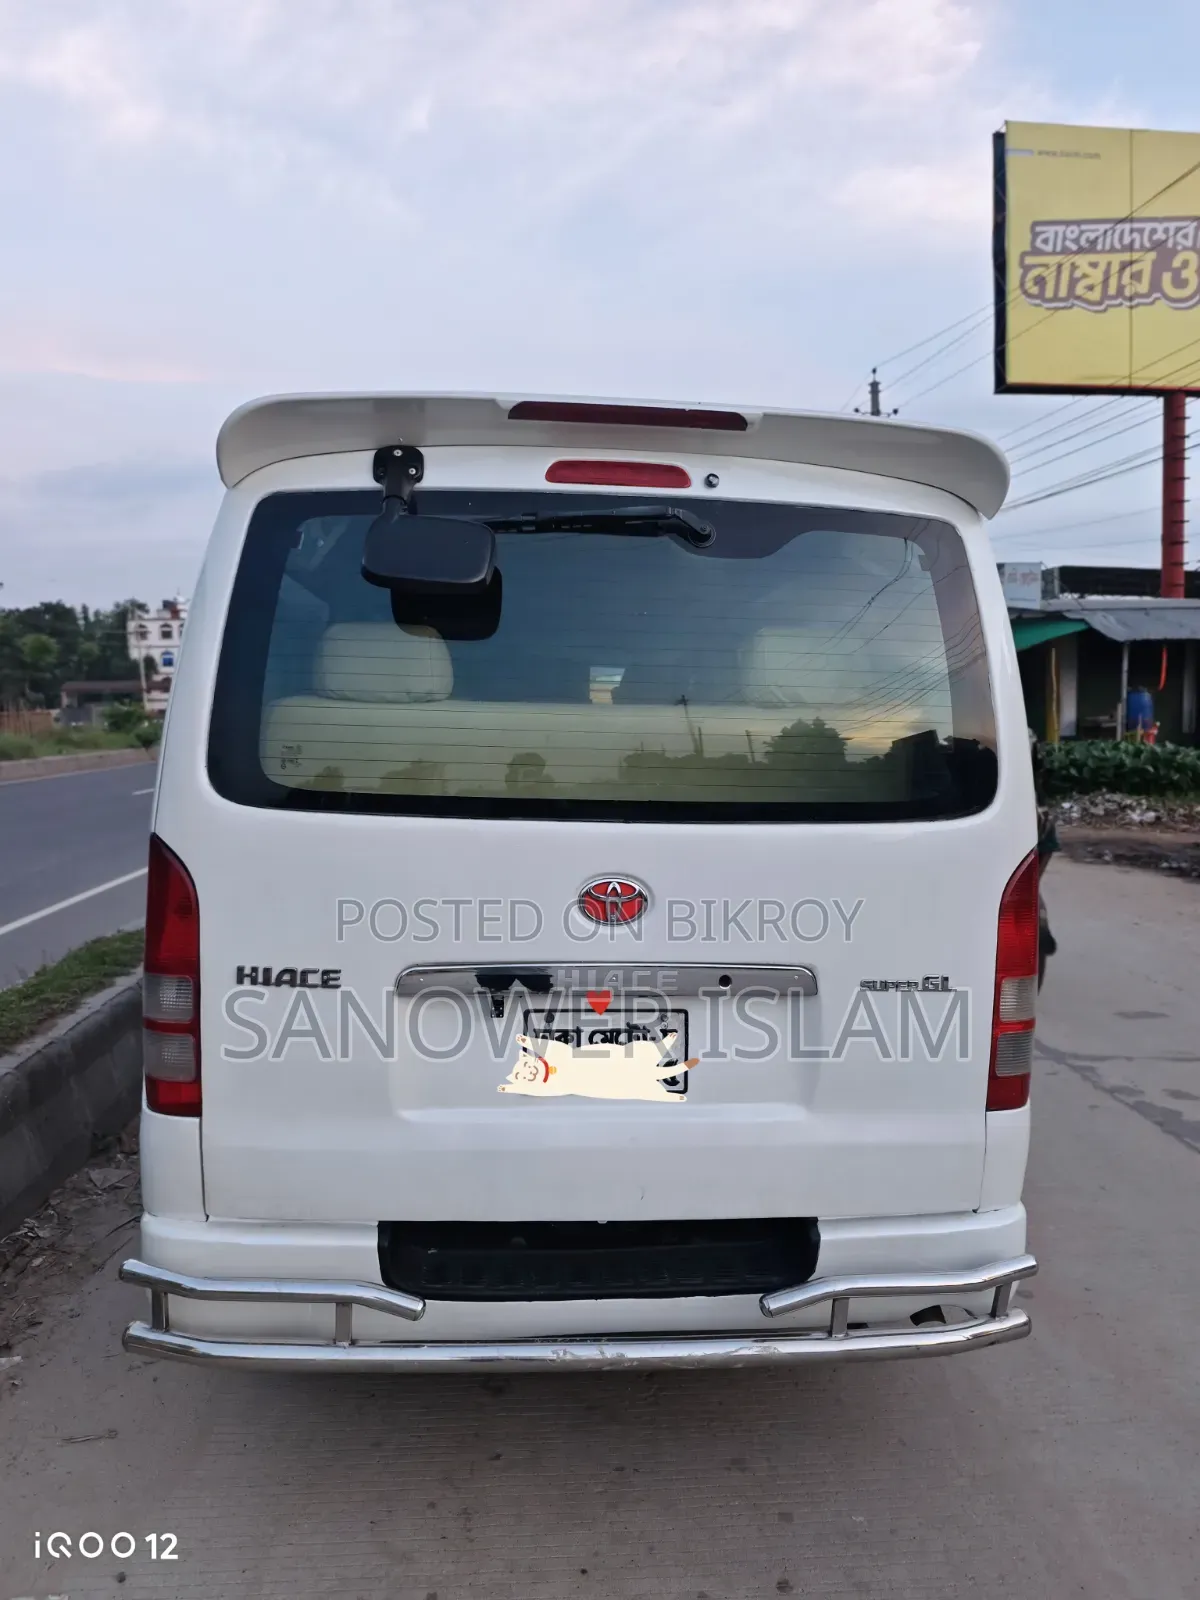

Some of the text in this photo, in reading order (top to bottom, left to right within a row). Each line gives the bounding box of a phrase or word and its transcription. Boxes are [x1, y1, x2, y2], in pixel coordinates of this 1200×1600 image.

[1034, 220, 1197, 252] বাংলাদেশের
[1024, 251, 1157, 301] নাম্বার
[236, 964, 342, 989] HIACE
[557, 969, 679, 991] HIACE
[859, 974, 958, 992] SUPER GL
